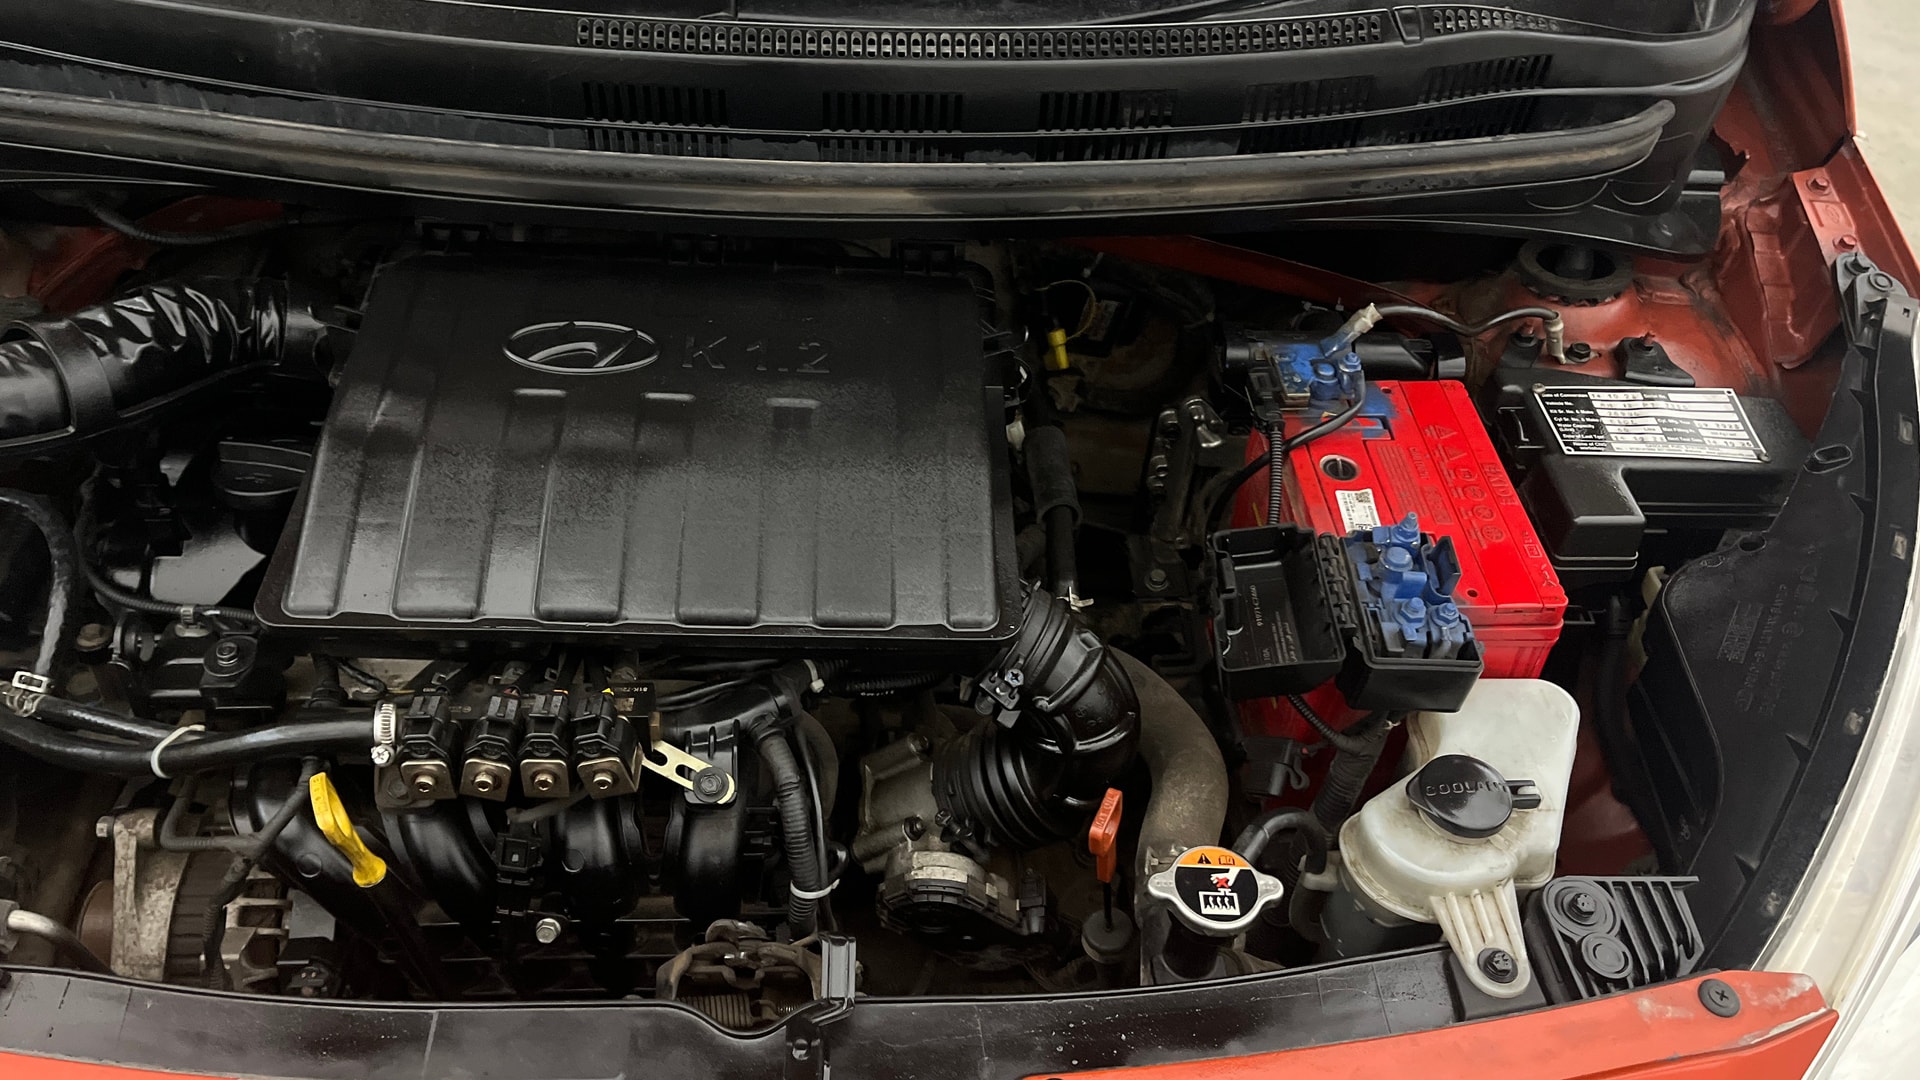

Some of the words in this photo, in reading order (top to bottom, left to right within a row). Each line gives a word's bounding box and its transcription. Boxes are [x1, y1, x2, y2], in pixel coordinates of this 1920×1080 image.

[682, 335, 728, 371] K
[745, 340, 831, 374] 1.2
[1425, 779, 1508, 798] COOLANT
